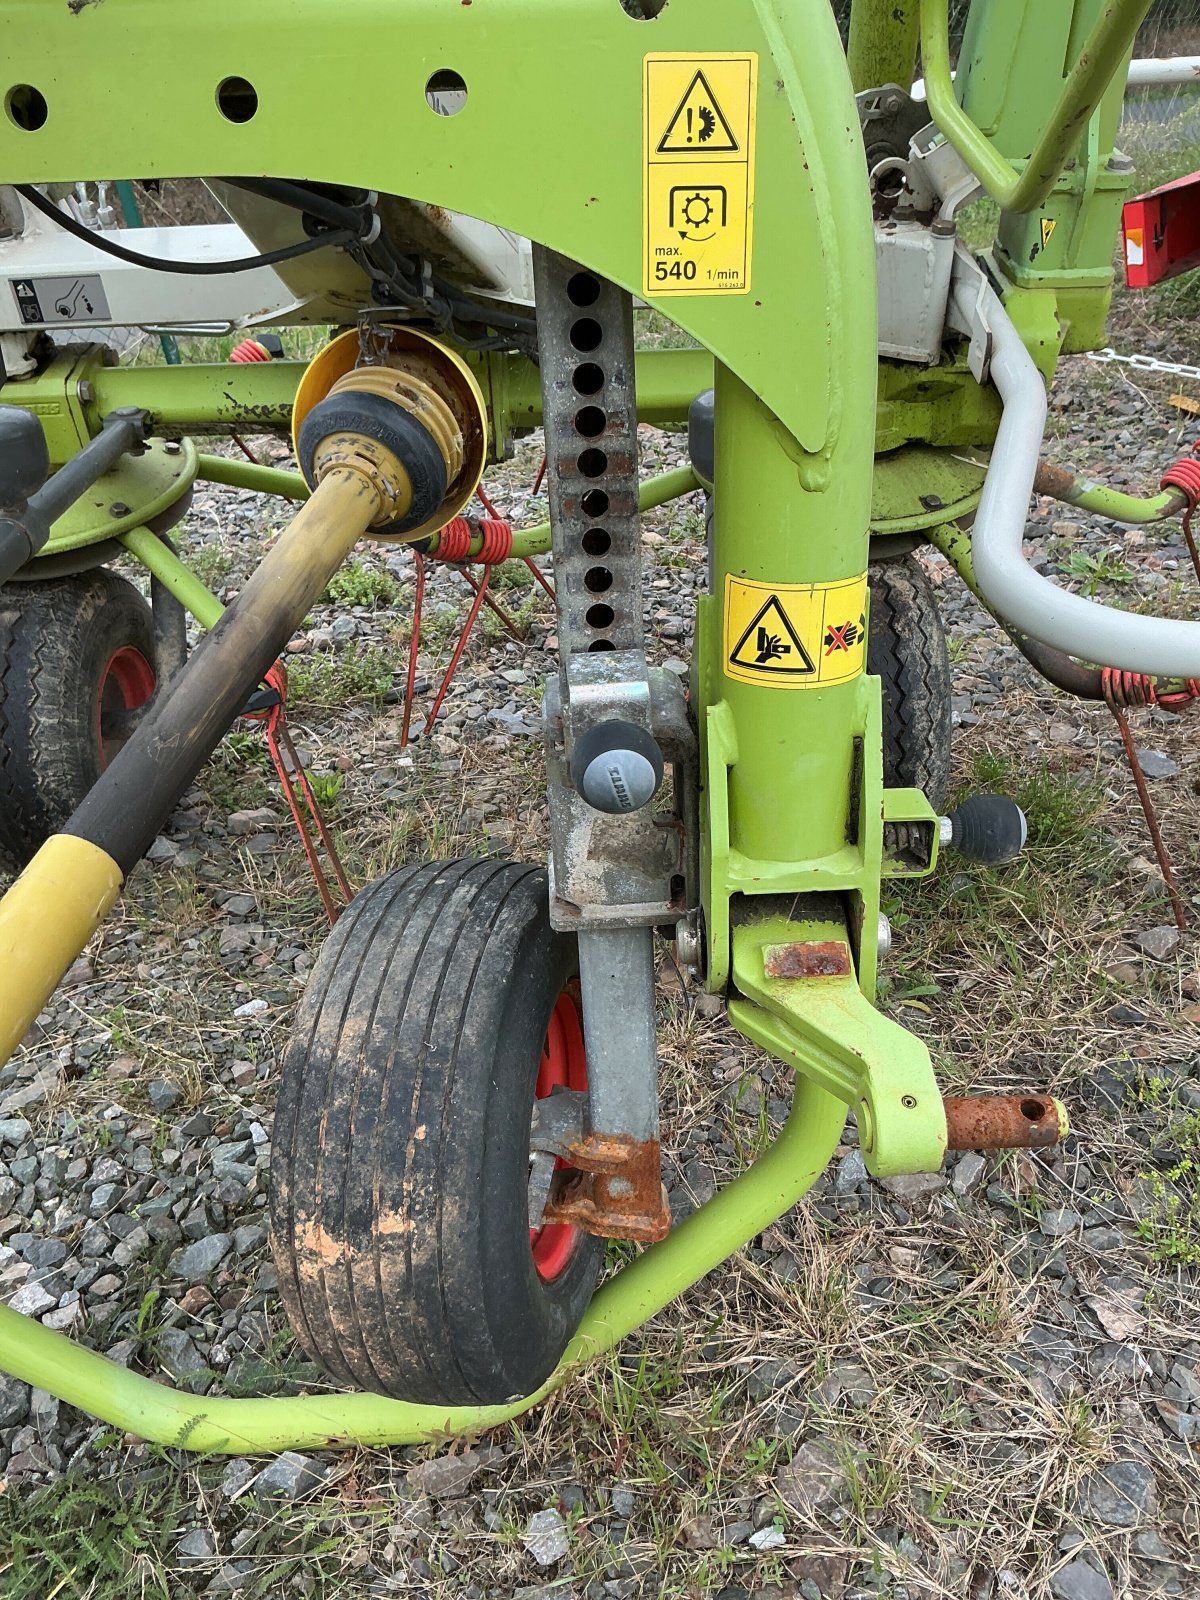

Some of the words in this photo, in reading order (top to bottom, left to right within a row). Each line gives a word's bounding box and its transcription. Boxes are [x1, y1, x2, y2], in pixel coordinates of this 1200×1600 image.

[655, 247, 683, 256] max.
[655, 260, 697, 281] 540
[706, 268, 739, 281] 1/min
